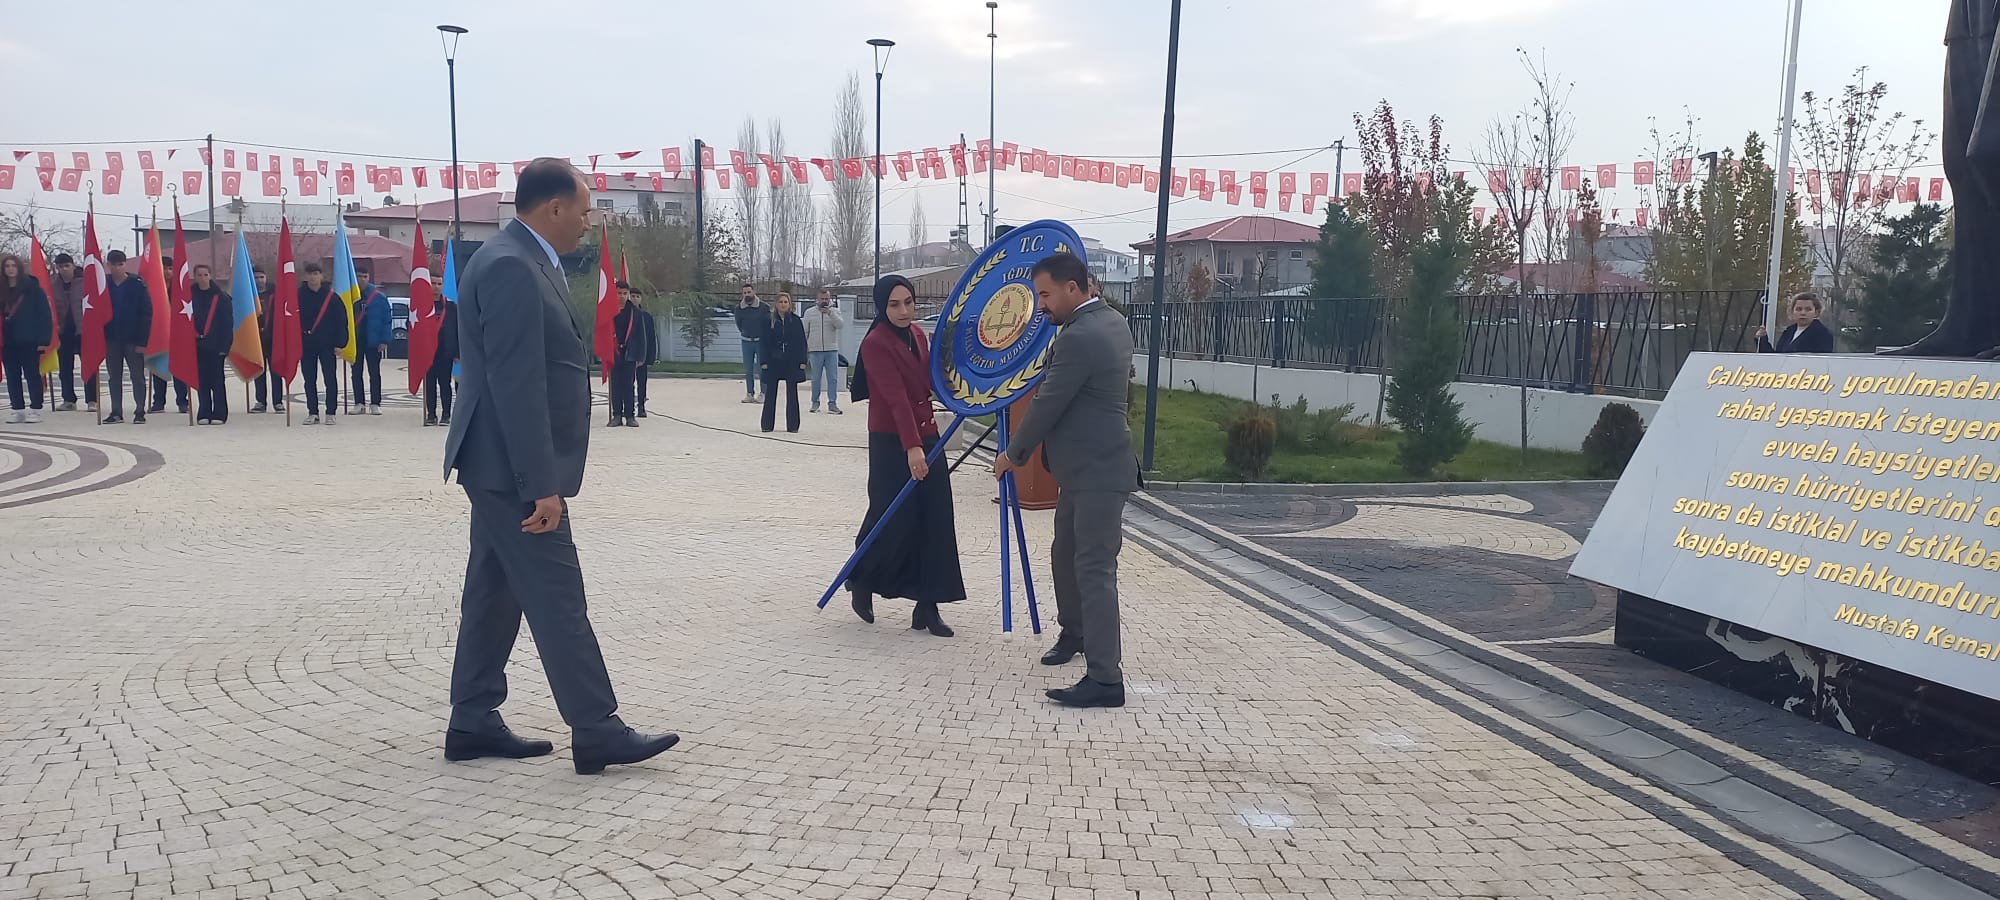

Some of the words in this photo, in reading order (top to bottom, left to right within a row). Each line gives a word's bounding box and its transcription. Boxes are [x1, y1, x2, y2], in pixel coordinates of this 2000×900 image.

[1020, 234, 1044, 253] T.C.
[1706, 365, 1835, 394] Çalışmadan,
[1717, 399, 1777, 421] rahat
[1776, 407, 1889, 432] yaşamak
[1763, 438, 1839, 463] evvela
[1727, 471, 1790, 494] sonra
[1793, 474, 1982, 522] hürriyetlerini
[1673, 497, 1733, 521] sonra
[1735, 503, 1765, 527] da
[1767, 511, 1858, 543] istiklal
[1860, 527, 1893, 550] ve
[1674, 527, 1812, 577] kaybetmeye
[1835, 603, 1920, 640] Mustafa
